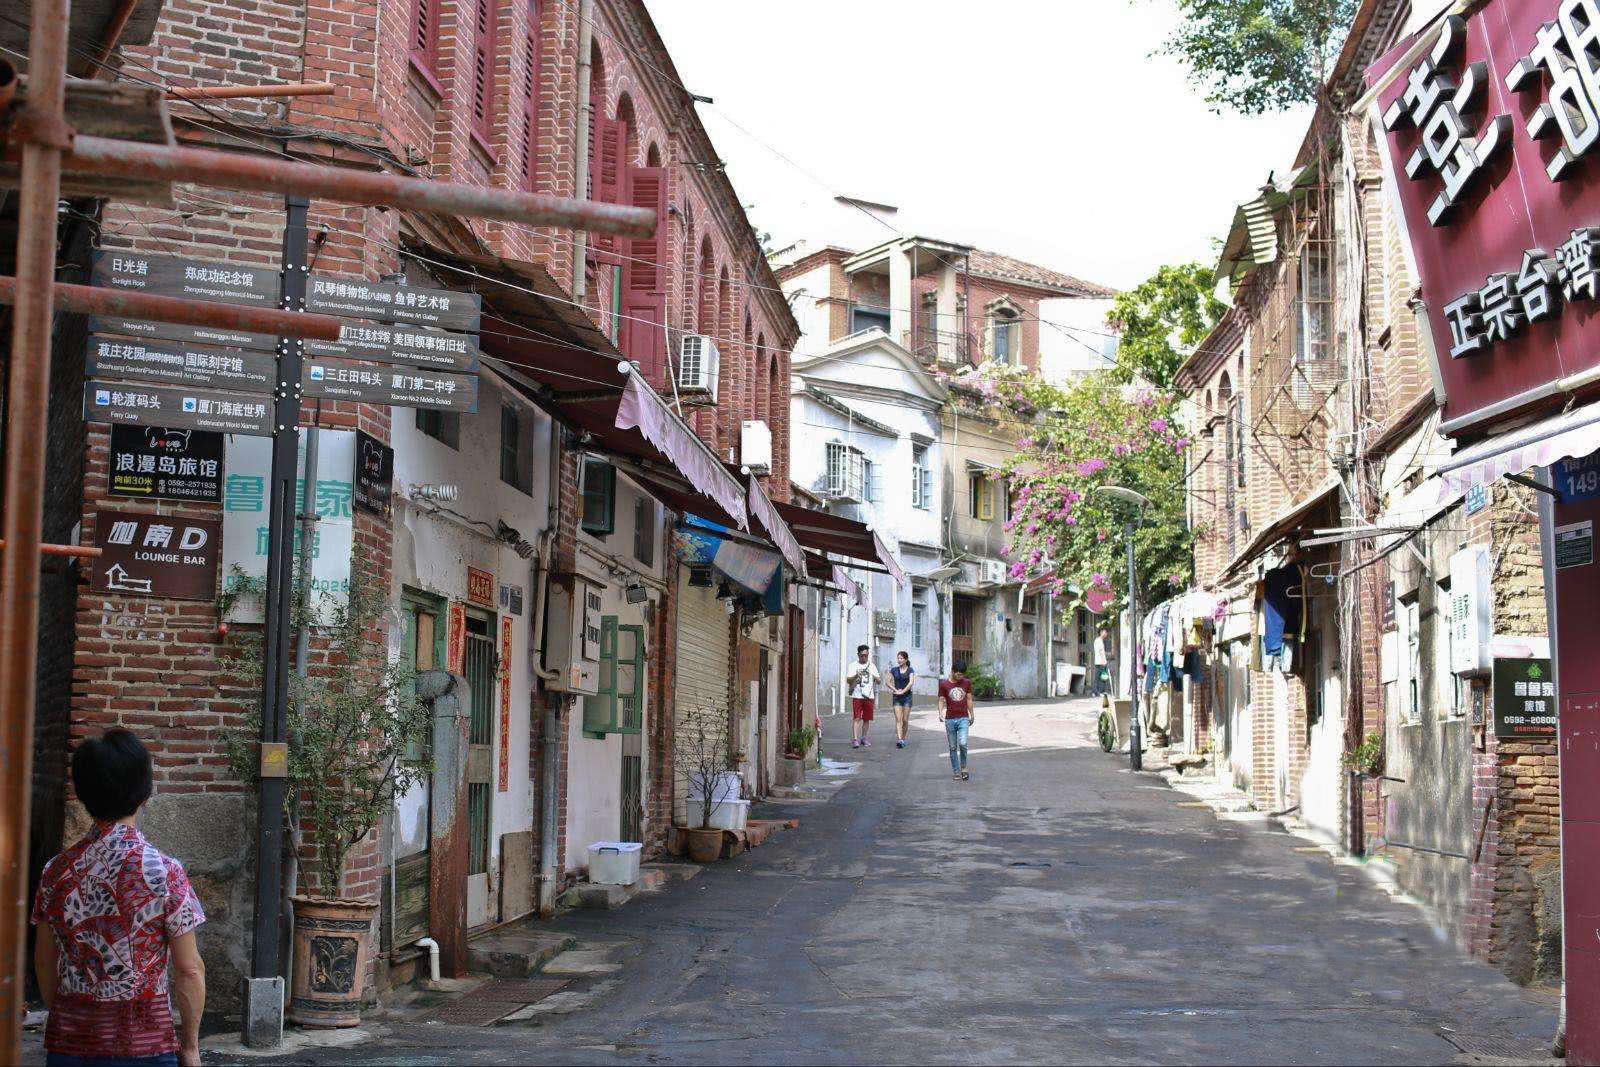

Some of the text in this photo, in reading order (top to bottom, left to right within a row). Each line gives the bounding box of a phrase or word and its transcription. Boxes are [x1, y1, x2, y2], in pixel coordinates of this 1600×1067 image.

[112, 258, 148, 275] 日光岩
[184, 266, 254, 287] 郑成功纪念馆
[394, 291, 450, 311] 鱼骨艺术馆
[1443, 228, 1597, 360] 正宗台湾
[143, 324, 155, 332] Park
[393, 332, 467, 354] 美国领事馆旧址
[185, 352, 244, 372] 国际刻字馆
[325, 368, 382, 386] 三丘田码头
[392, 374, 456, 394] 厦门第二中学
[111, 391, 161, 409] 轮渡码头
[197, 399, 266, 418] 厦门海底世界
[116, 452, 218, 478] 浪漫岛旅馆
[114, 475, 152, 486] 向前30米
[134, 551, 206, 566] LOUNGE BAR
